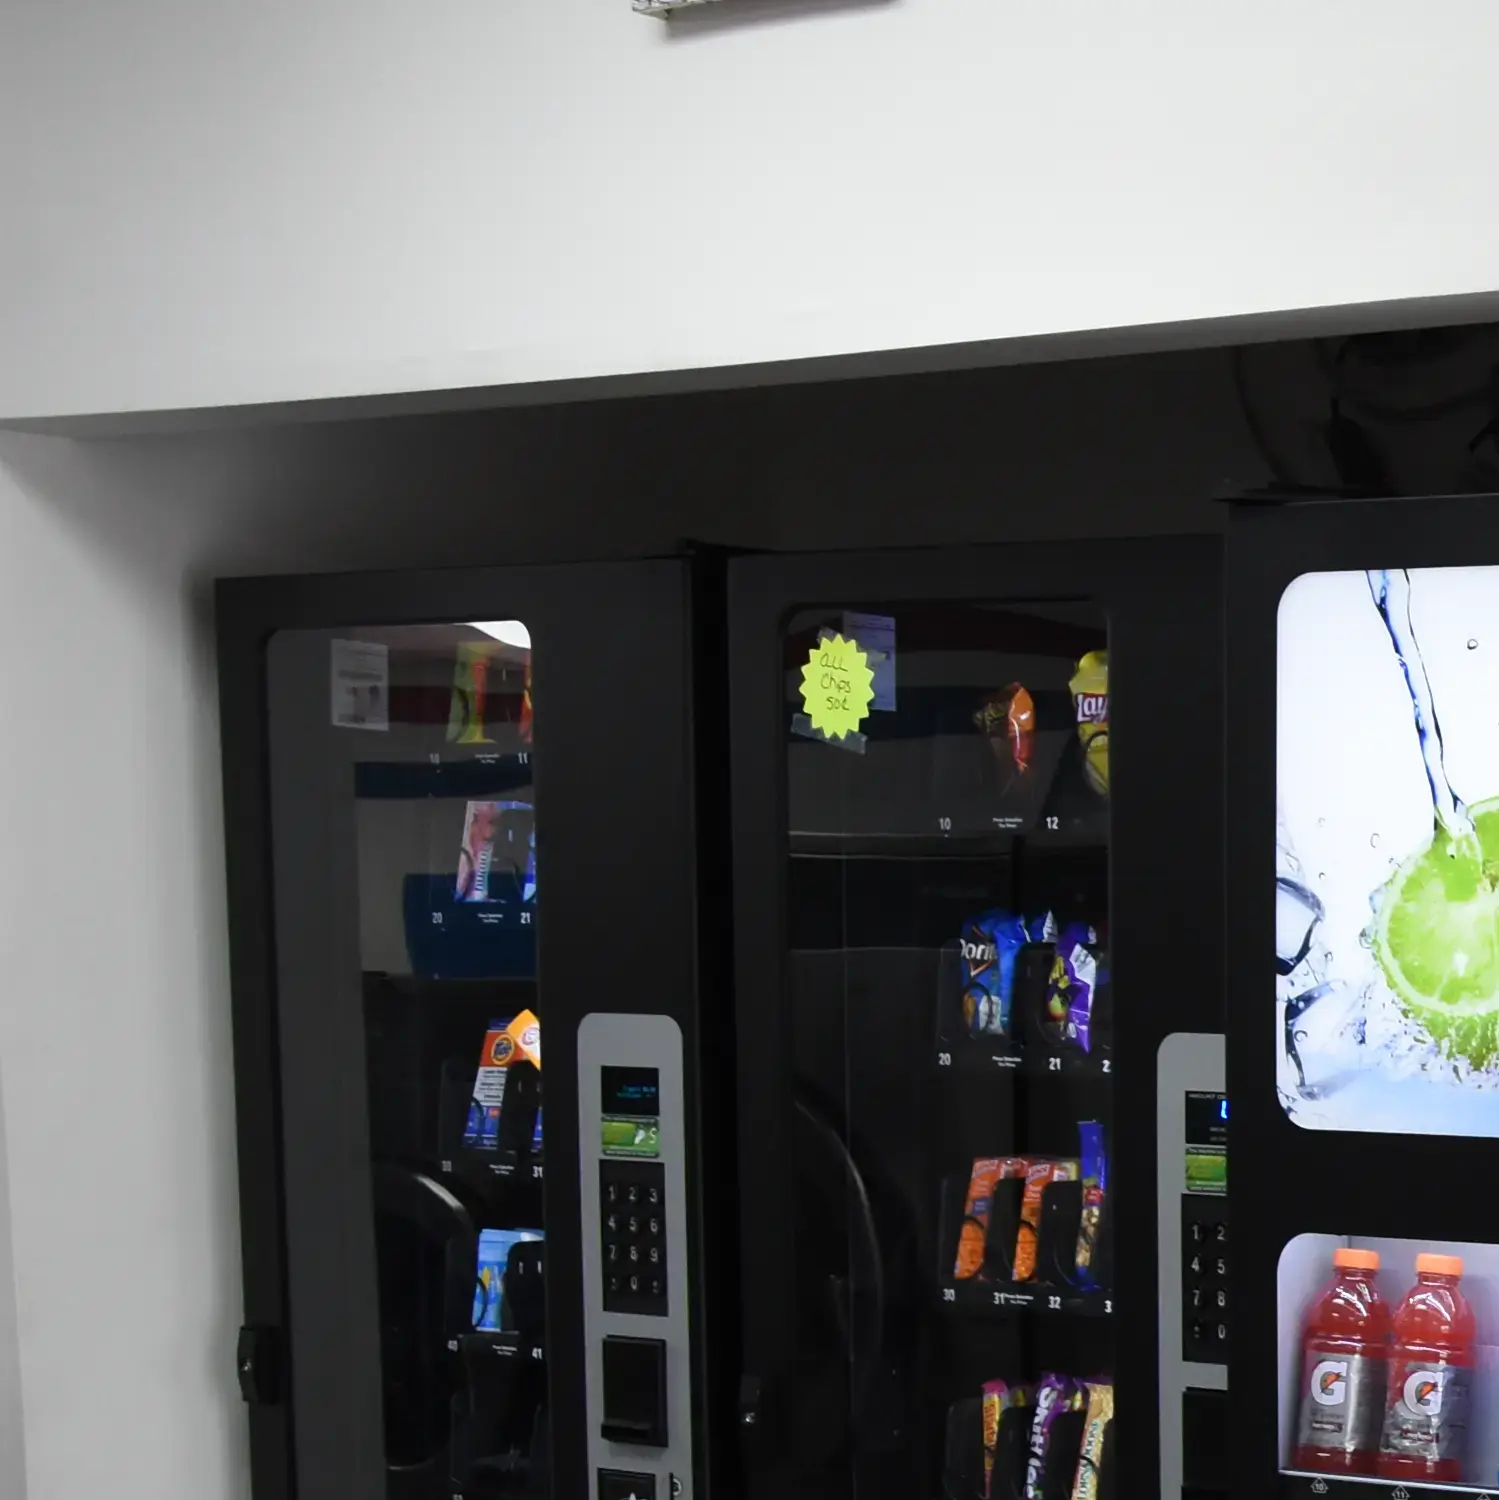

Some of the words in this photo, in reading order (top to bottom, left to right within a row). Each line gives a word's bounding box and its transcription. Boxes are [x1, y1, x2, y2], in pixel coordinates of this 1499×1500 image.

[1045, 816, 1059, 829] 12
[1310, 1360, 1348, 1406] G
[1403, 1370, 1444, 1417] G
